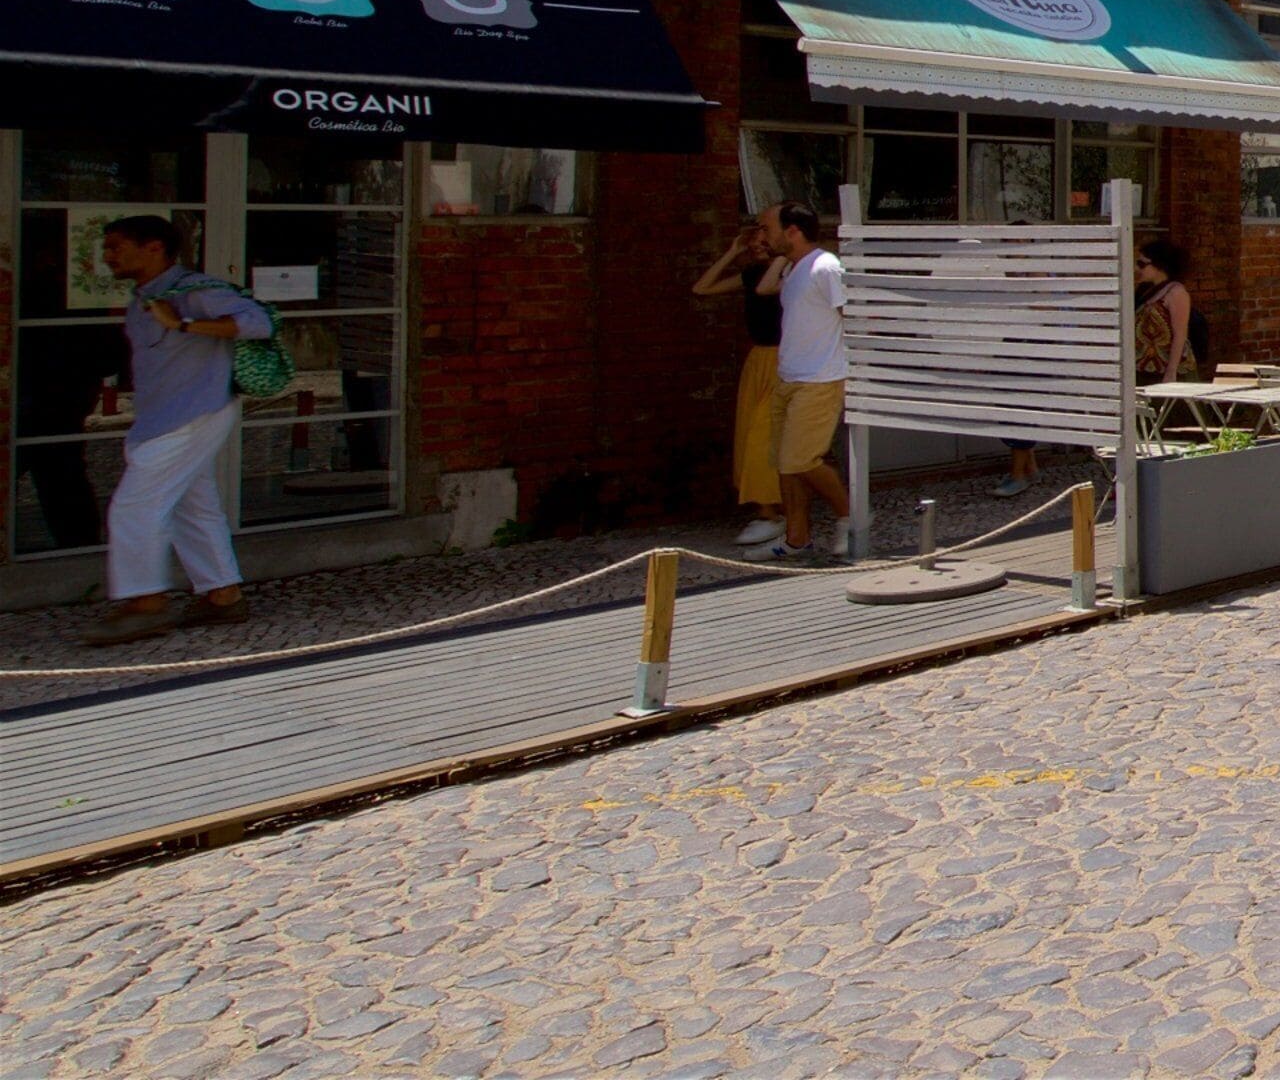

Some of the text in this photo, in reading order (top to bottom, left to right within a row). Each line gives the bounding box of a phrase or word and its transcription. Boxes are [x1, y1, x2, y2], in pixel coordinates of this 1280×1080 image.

[272, 88, 432, 116] ORGANII
[308, 116, 406, 133] Cosmética Bio
